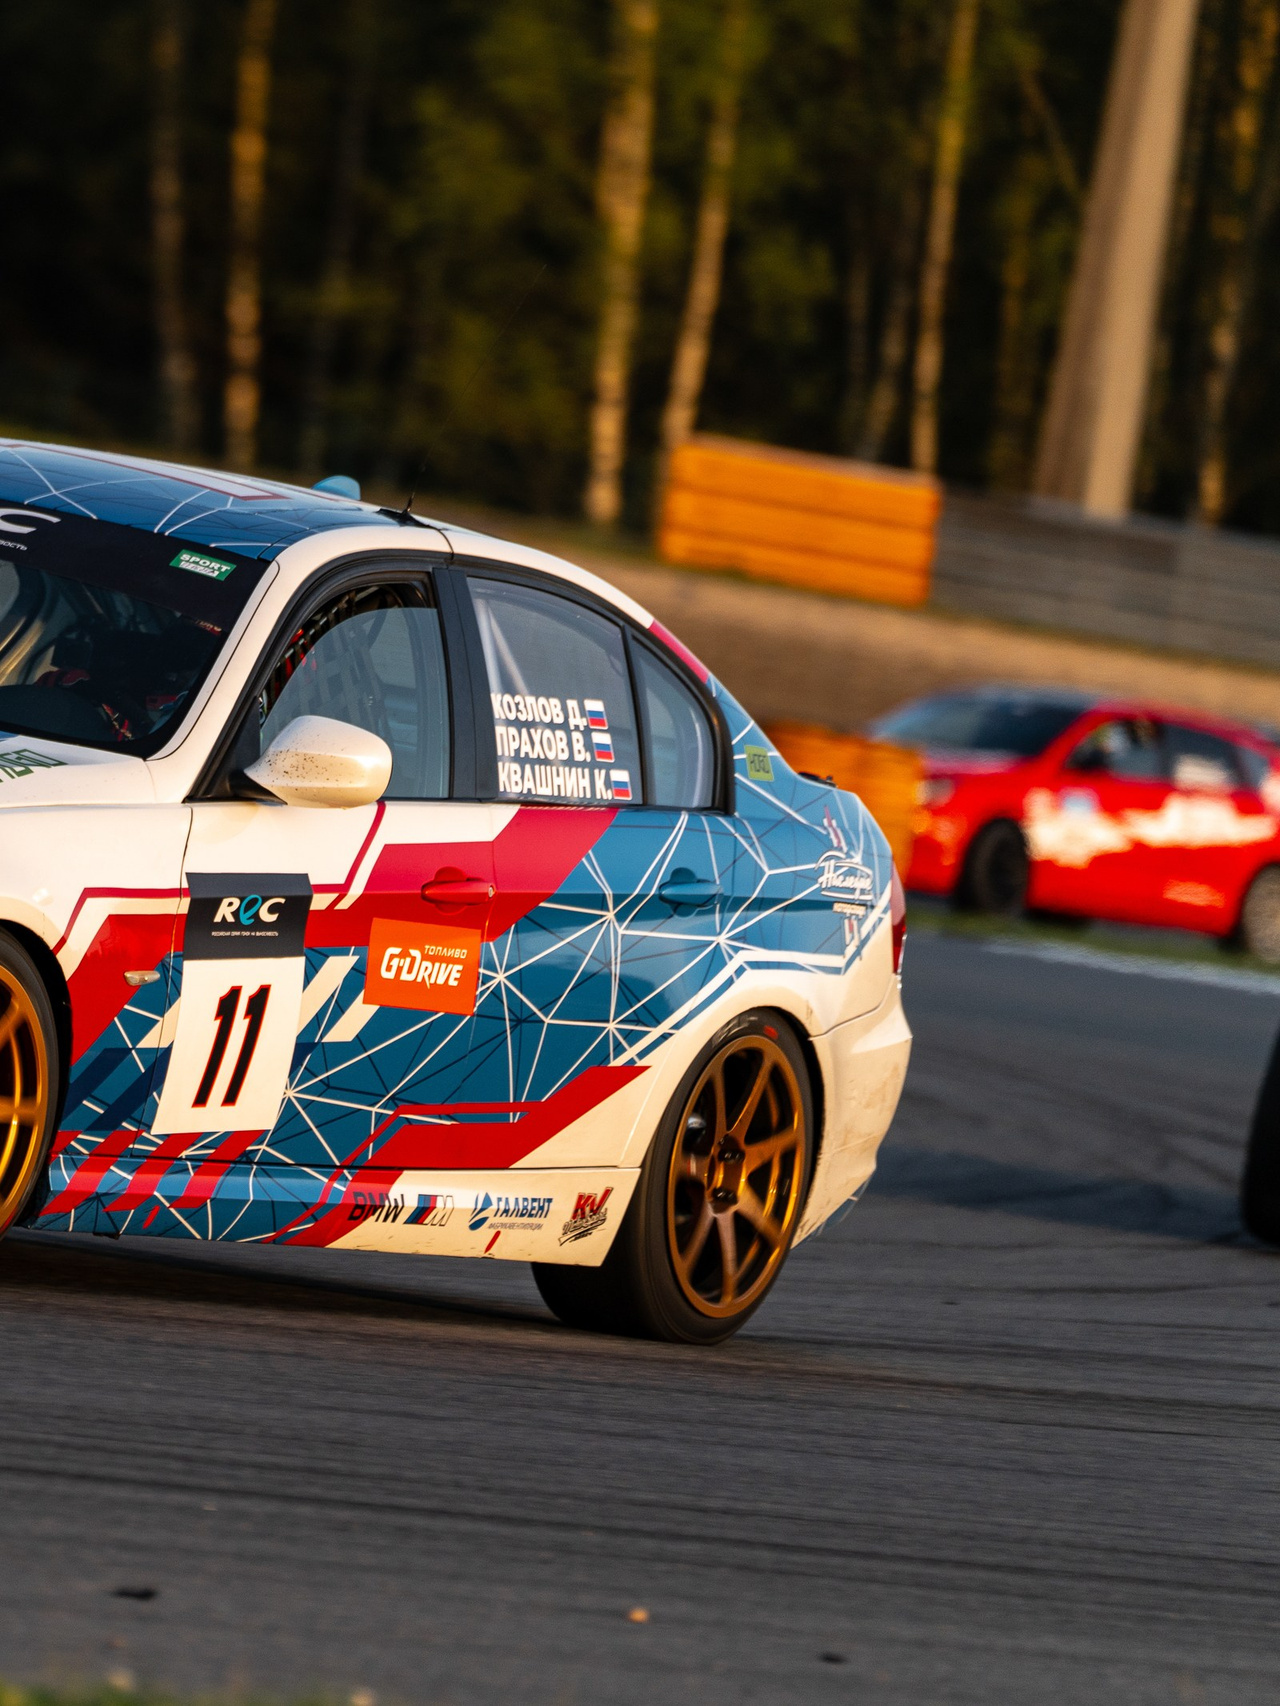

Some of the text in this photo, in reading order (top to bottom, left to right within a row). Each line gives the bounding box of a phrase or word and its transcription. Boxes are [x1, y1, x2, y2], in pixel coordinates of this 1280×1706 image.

[180, 553, 231, 573] SPORT
[490, 693, 588, 731] КОЗЛОВ Д.
[495, 726, 591, 762] ПРАХОВ В.
[498, 762, 612, 800] КВАШНИН К.
[424, 945, 468, 959] ТОПЛИВО
[191, 984, 271, 1108] 11
[347, 1191, 405, 1223] BMW
[493, 1196, 553, 1218] ГАЛВЕНТ
